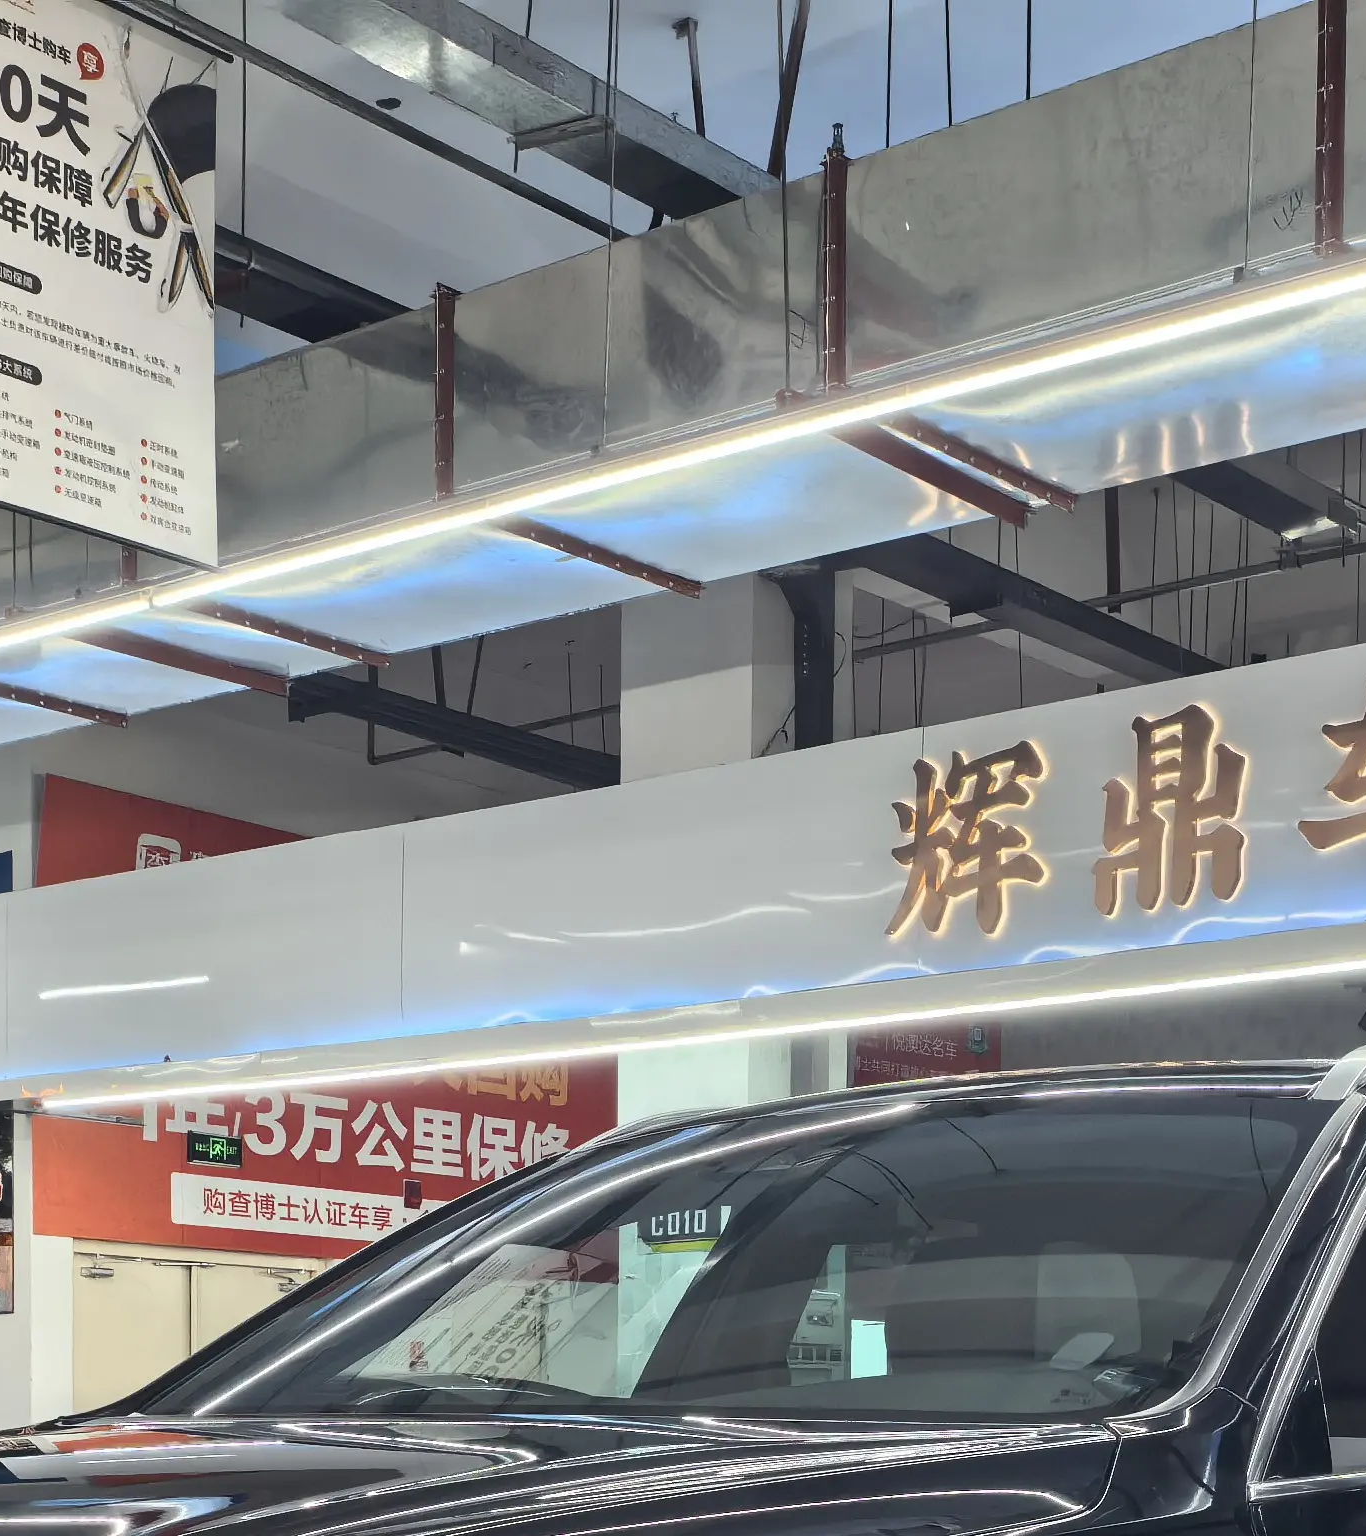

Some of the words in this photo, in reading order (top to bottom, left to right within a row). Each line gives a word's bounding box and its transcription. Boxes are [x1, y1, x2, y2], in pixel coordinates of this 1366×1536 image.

[82, 50, 99, 74] 享
[202, 1186, 393, 1232] 购查博士认证车享
